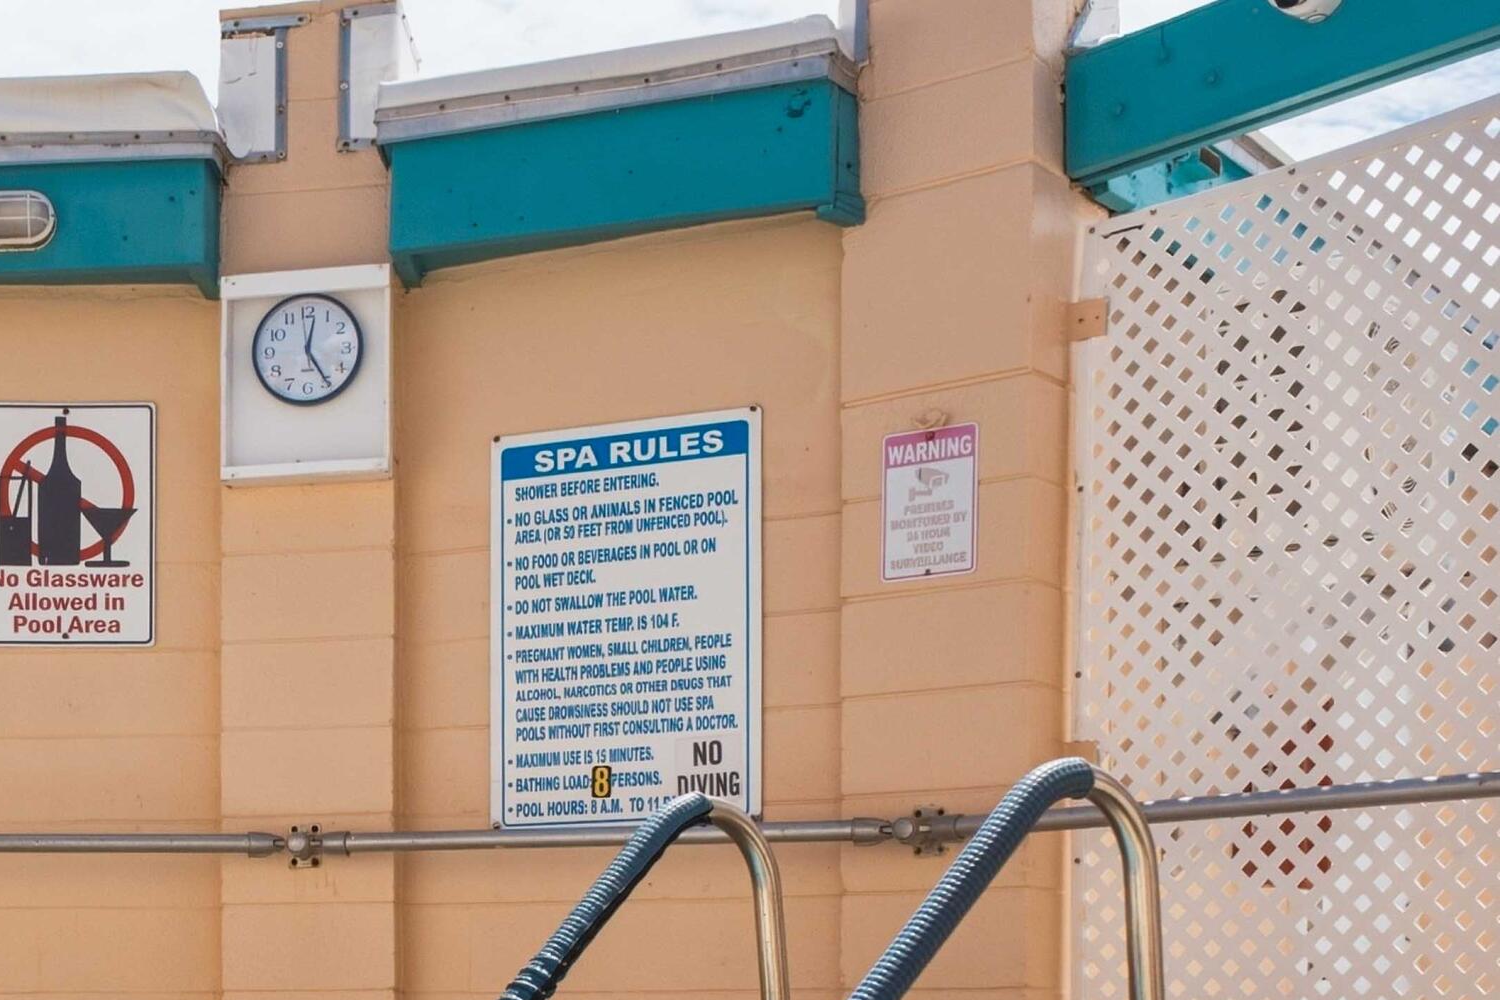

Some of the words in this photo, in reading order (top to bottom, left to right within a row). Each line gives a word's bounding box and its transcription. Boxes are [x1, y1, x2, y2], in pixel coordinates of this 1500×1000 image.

[285, 312, 294, 325] 11
[301, 306, 315, 319] 12
[270, 329, 285, 341] 10
[336, 322, 345, 334] 2
[264, 347, 275, 359] 9
[341, 342, 352, 354] 3
[270, 365, 281, 377] 8
[335, 362, 347, 373] 4
[284, 378, 294, 391] 7
[302, 382, 313, 394] 6
[321, 376, 332, 388] 5
[534, 446, 598, 472] SPA
[610, 430, 724, 464] RULES
[888, 435, 972, 465] WARNING
[515, 484, 558, 502] SHOWER
[560, 479, 600, 496] BEFORE
[604, 472, 659, 492] ENTERING.
[515, 512, 530, 526] NO
[534, 508, 568, 524] GLASS
[572, 506, 588, 522] OR
[591, 500, 640, 520] ANIMALS
[644, 498, 656, 514] IN
[659, 493, 704, 512] FENCED
[708, 490, 738, 506] POOL
[515, 529, 542, 544] AREA
[544, 528, 560, 544] (OR
[564, 528, 574, 540] 50
[578, 523, 602, 538] FEET
[605, 519, 632, 536] FROM
[636, 514, 690, 532] UNFENCED
[694, 510, 728, 528] POOL).
[515, 557, 529, 570] NO
[532, 554, 558, 568] FOOD
[562, 552, 575, 566] OR
[578, 546, 636, 564] BEVERAGES
[640, 544, 650, 558] IN
[654, 542, 680, 558] POOL
[684, 540, 698, 554] OR
[701, 538, 716, 552] ON
[26, 569, 143, 587] Glassware
[515, 575, 540, 590] POOL
[544, 572, 564, 588] WET
[567, 570, 596, 586] DECK.
[8, 593, 97, 610] Allowed
[105, 593, 124, 610] in
[515, 600, 529, 614] DO
[532, 599, 552, 613] NOT
[555, 593, 603, 612] SWALLOW
[606, 592, 626, 606] THE
[629, 589, 656, 604] POOL
[659, 585, 697, 602] WATER.
[13, 616, 62, 633] Pool
[67, 616, 120, 633] Area
[516, 623, 564, 640] MAXIMUM
[568, 620, 602, 636] WATER
[605, 618, 634, 634] TEMP.
[637, 616, 648, 630] IS
[650, 614, 669, 629] 104
[672, 613, 679, 628] F.
[516, 646, 564, 662] PREGNANT
[567, 643, 604, 660] WOMEN,
[608, 640, 638, 656] SMALL
[641, 636, 692, 654] CHILDREN,
[695, 634, 732, 649] PEOPLE
[516, 669, 539, 684] WITH
[542, 666, 578, 682] HEALTH
[580, 662, 630, 679] PROBLEMS
[634, 660, 652, 675] AND
[656, 658, 692, 674] PEOPLE
[696, 654, 726, 670] USING
[516, 688, 560, 702] ALCOHOL,
[564, 683, 616, 698] NARCOTICS
[620, 682, 632, 694] OR
[636, 680, 668, 694] OTHER
[671, 677, 704, 691] DRUGS
[707, 676, 732, 688] THAT
[516, 708, 546, 722] CAUSE
[549, 702, 608, 720] DROWSINESS
[611, 700, 648, 716] SHOULD
[652, 699, 671, 712] NOT
[674, 698, 693, 712] USE
[696, 696, 714, 710] SPA
[516, 725, 546, 742] POOLS
[548, 722, 591, 740] WITHOUT
[594, 720, 620, 737] FIRST
[622, 717, 683, 736] CONSULTING
[686, 716, 692, 732] A
[696, 714, 738, 730] DOCTOR.
[516, 752, 560, 768] MAXIMUM
[563, 750, 582, 765] USE
[584, 750, 592, 764] IS
[596, 748, 606, 763] 15
[609, 746, 654, 762] MINUTES.
[692, 740, 722, 766] NO
[516, 776, 560, 792] BATHING
[594, 767, 609, 796] 8
[612, 771, 662, 788] PERSONS.
[678, 772, 740, 796] DIVING
[516, 801, 544, 817] POOL
[547, 800, 588, 816] HOURS:
[591, 800, 597, 814] 8
[600, 799, 622, 814] A.M.
[630, 797, 644, 812] TO
[648, 796, 660, 810] 11
